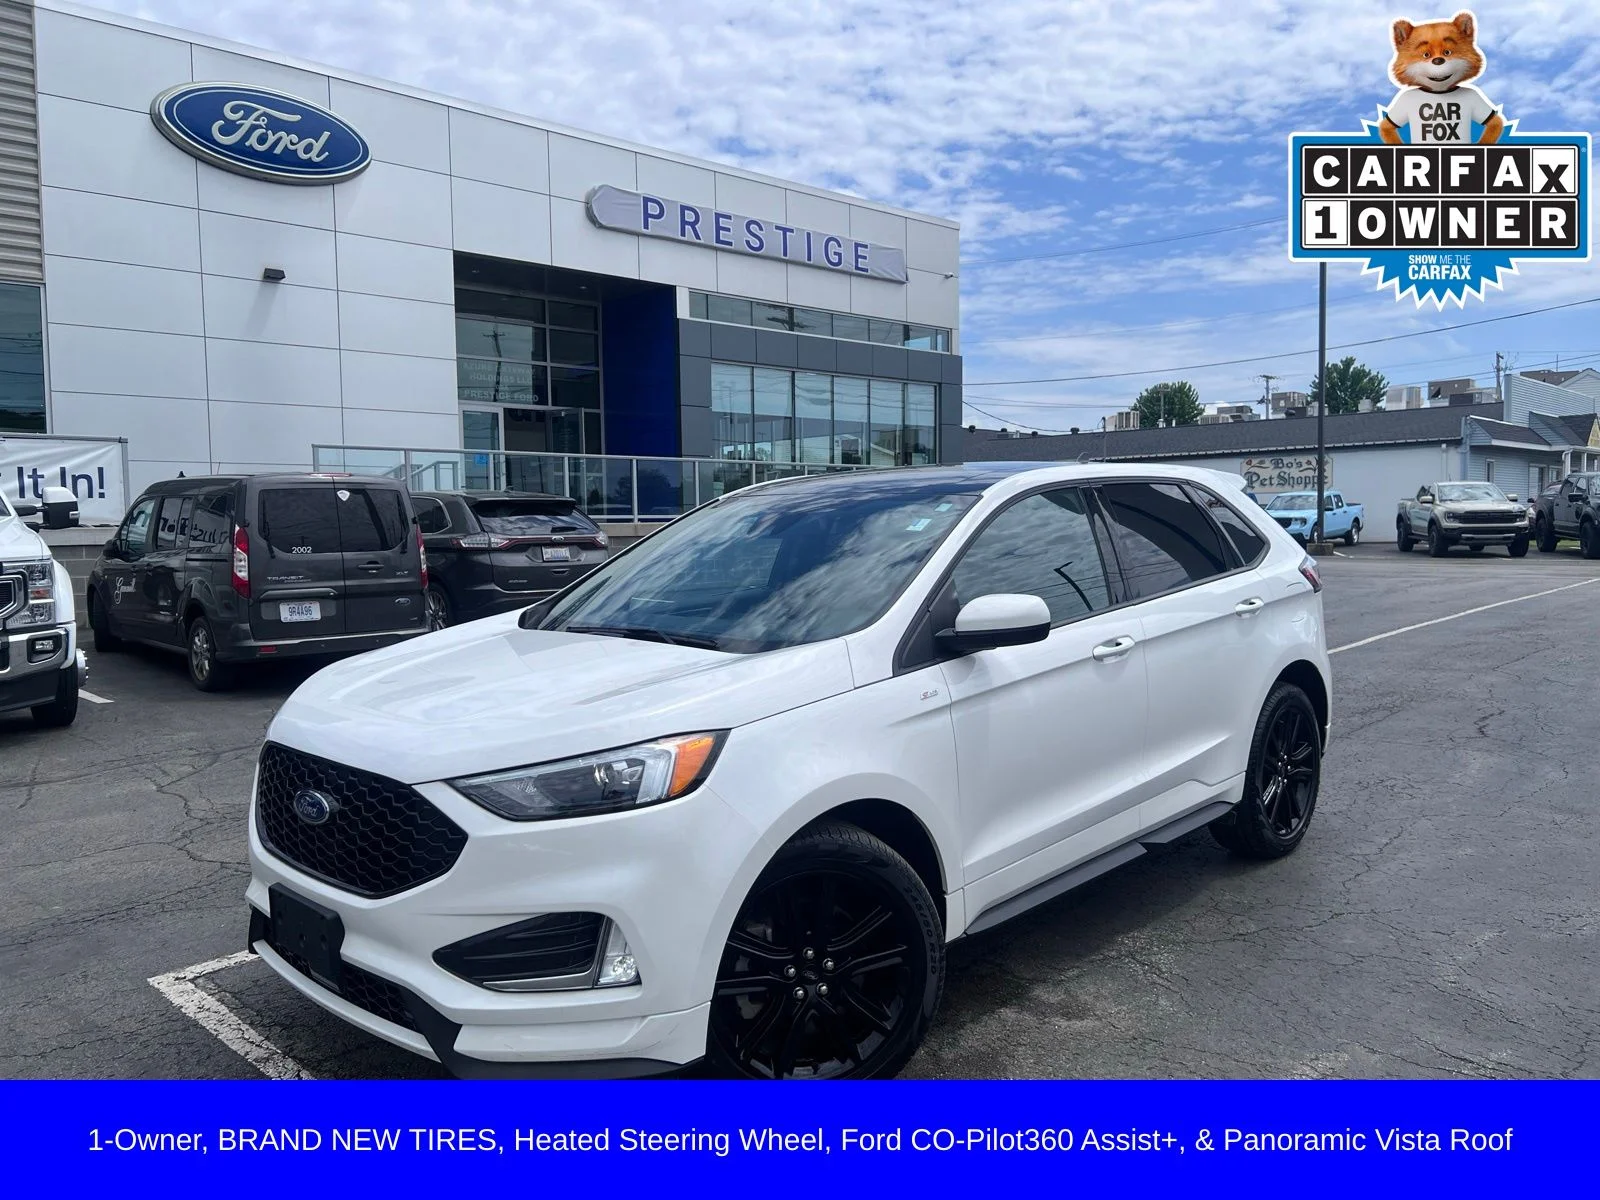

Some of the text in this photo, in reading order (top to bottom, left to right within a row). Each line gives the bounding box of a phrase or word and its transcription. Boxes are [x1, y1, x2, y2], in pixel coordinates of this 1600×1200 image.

[211, 100, 331, 163] Ford
[641, 195, 870, 274] PRESTIGE
[1270, 458, 1303, 469] Bo's
[17, 466, 105, 499] It In!
[1243, 471, 1275, 489] Pet
[291, 546, 313, 554] 2002
[299, 796, 320, 818] Ford
